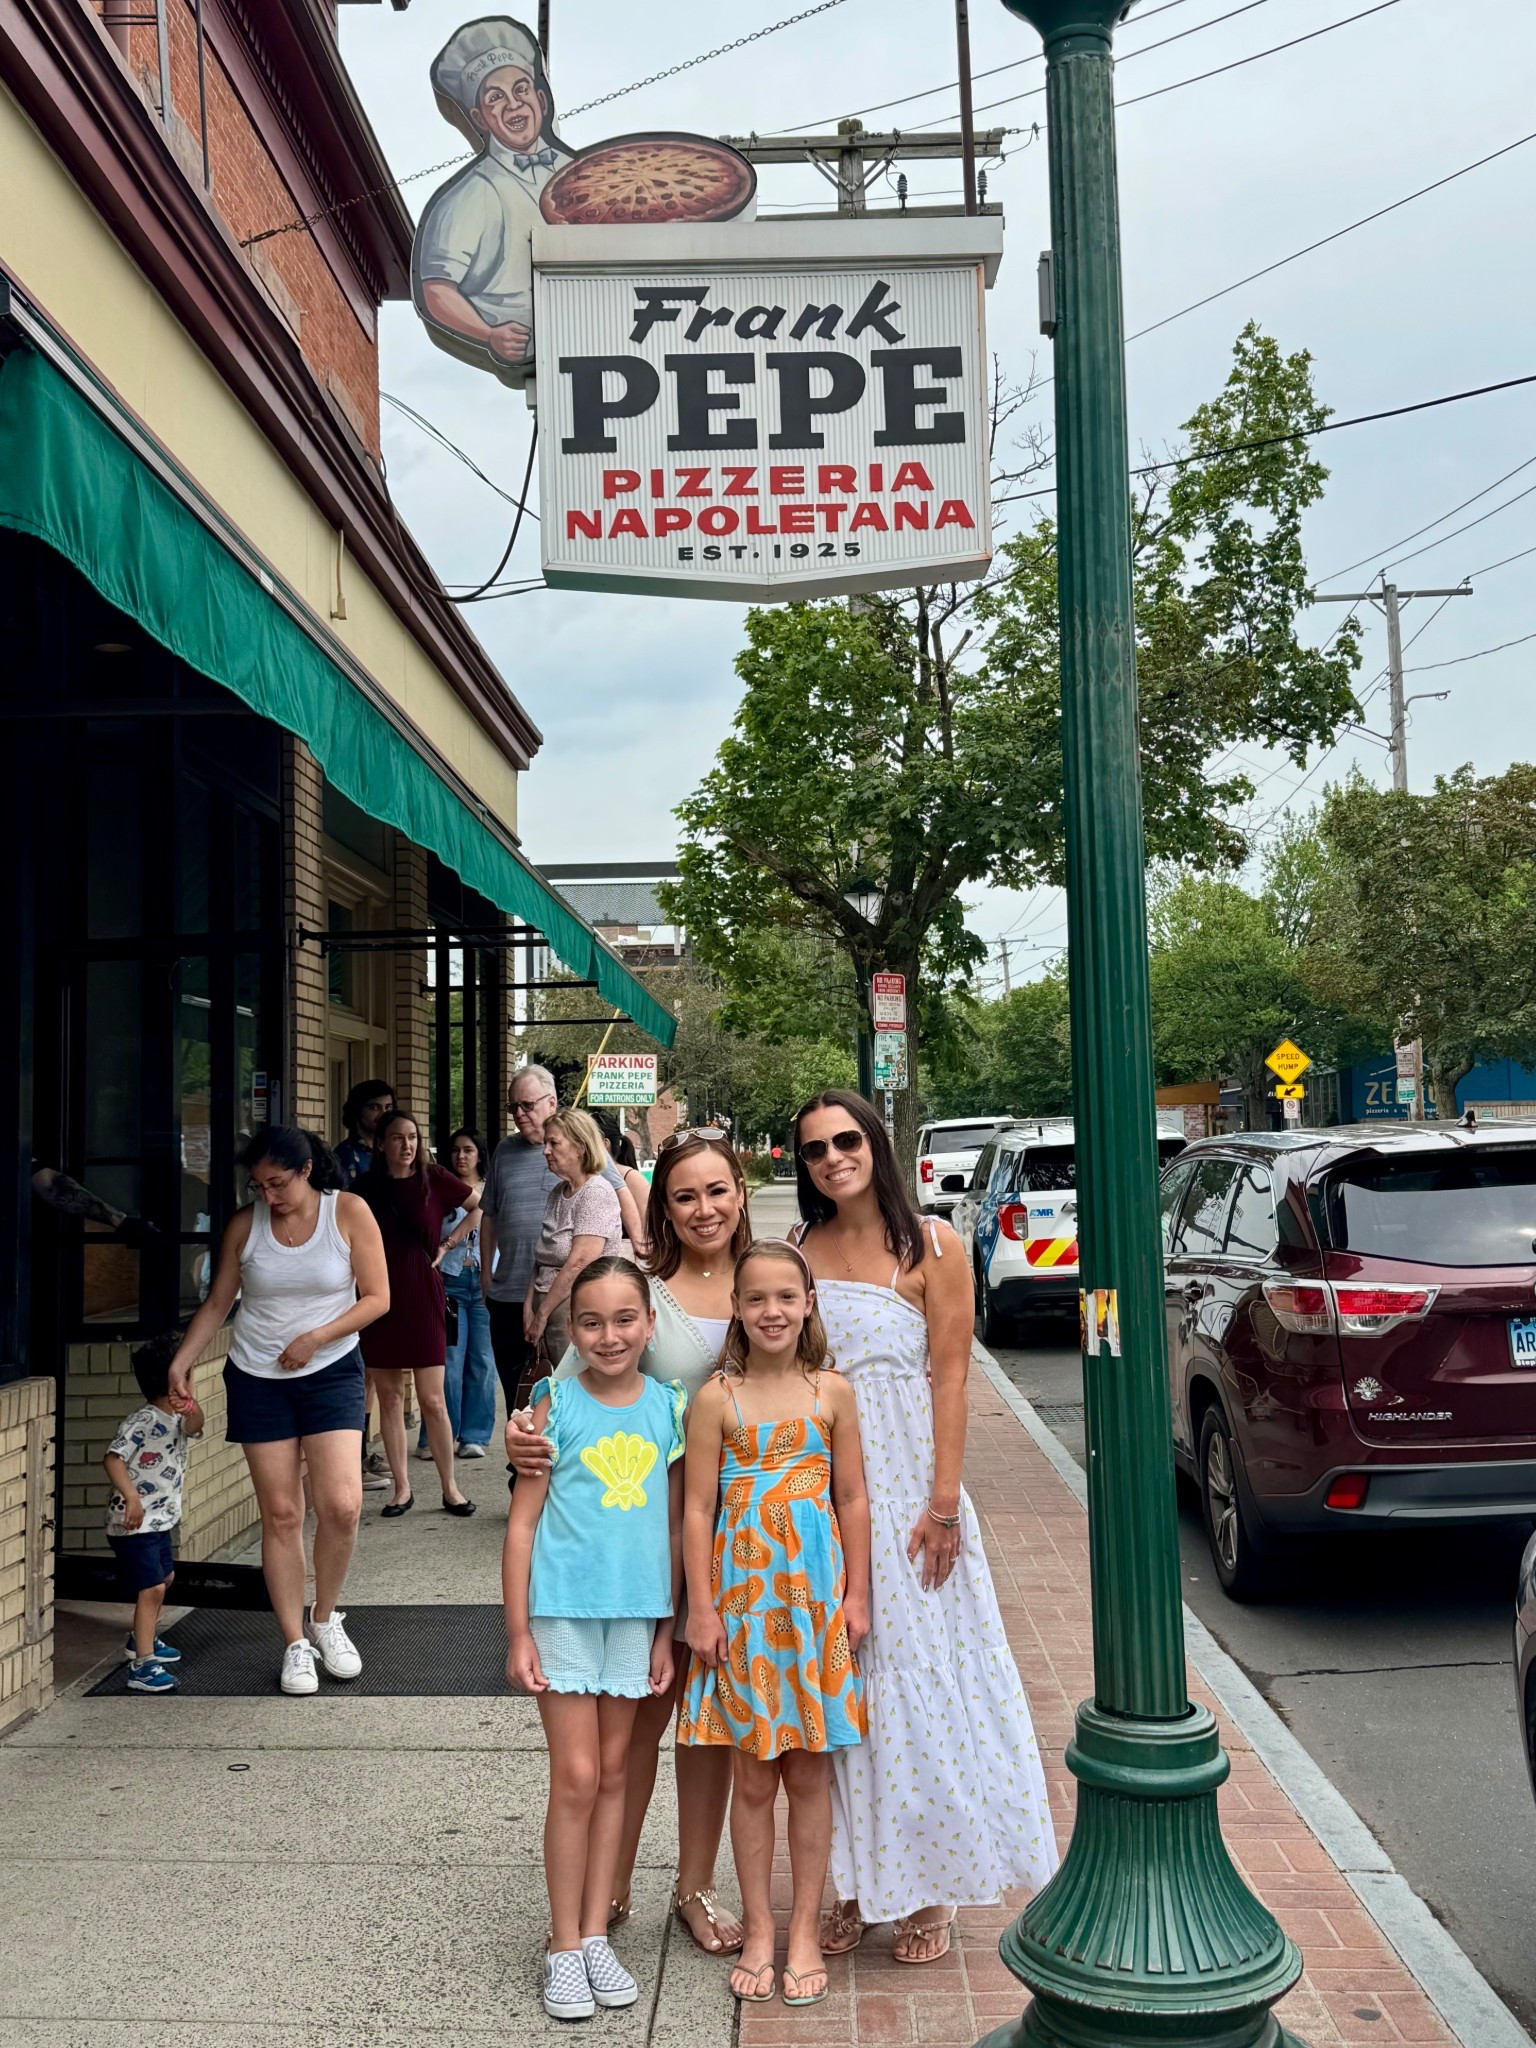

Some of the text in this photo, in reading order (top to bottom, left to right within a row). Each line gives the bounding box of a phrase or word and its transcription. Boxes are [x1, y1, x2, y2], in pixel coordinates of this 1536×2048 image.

[487, 52, 514, 64] Pepe
[629, 279, 907, 344] Frank
[558, 346, 966, 454] PEPE
[602, 461, 935, 499] PIZZERIA
[566, 499, 976, 540] NAPOLETANA
[678, 542, 861, 561] EST. 1925
[592, 1072, 652, 1080] FRANK PEPE
[599, 1082, 644, 1090] PIZZERIA
[590, 1094, 653, 1103] FOR PATRONS ONLY
[1368, 1412, 1453, 1421] HIGHLANDER
